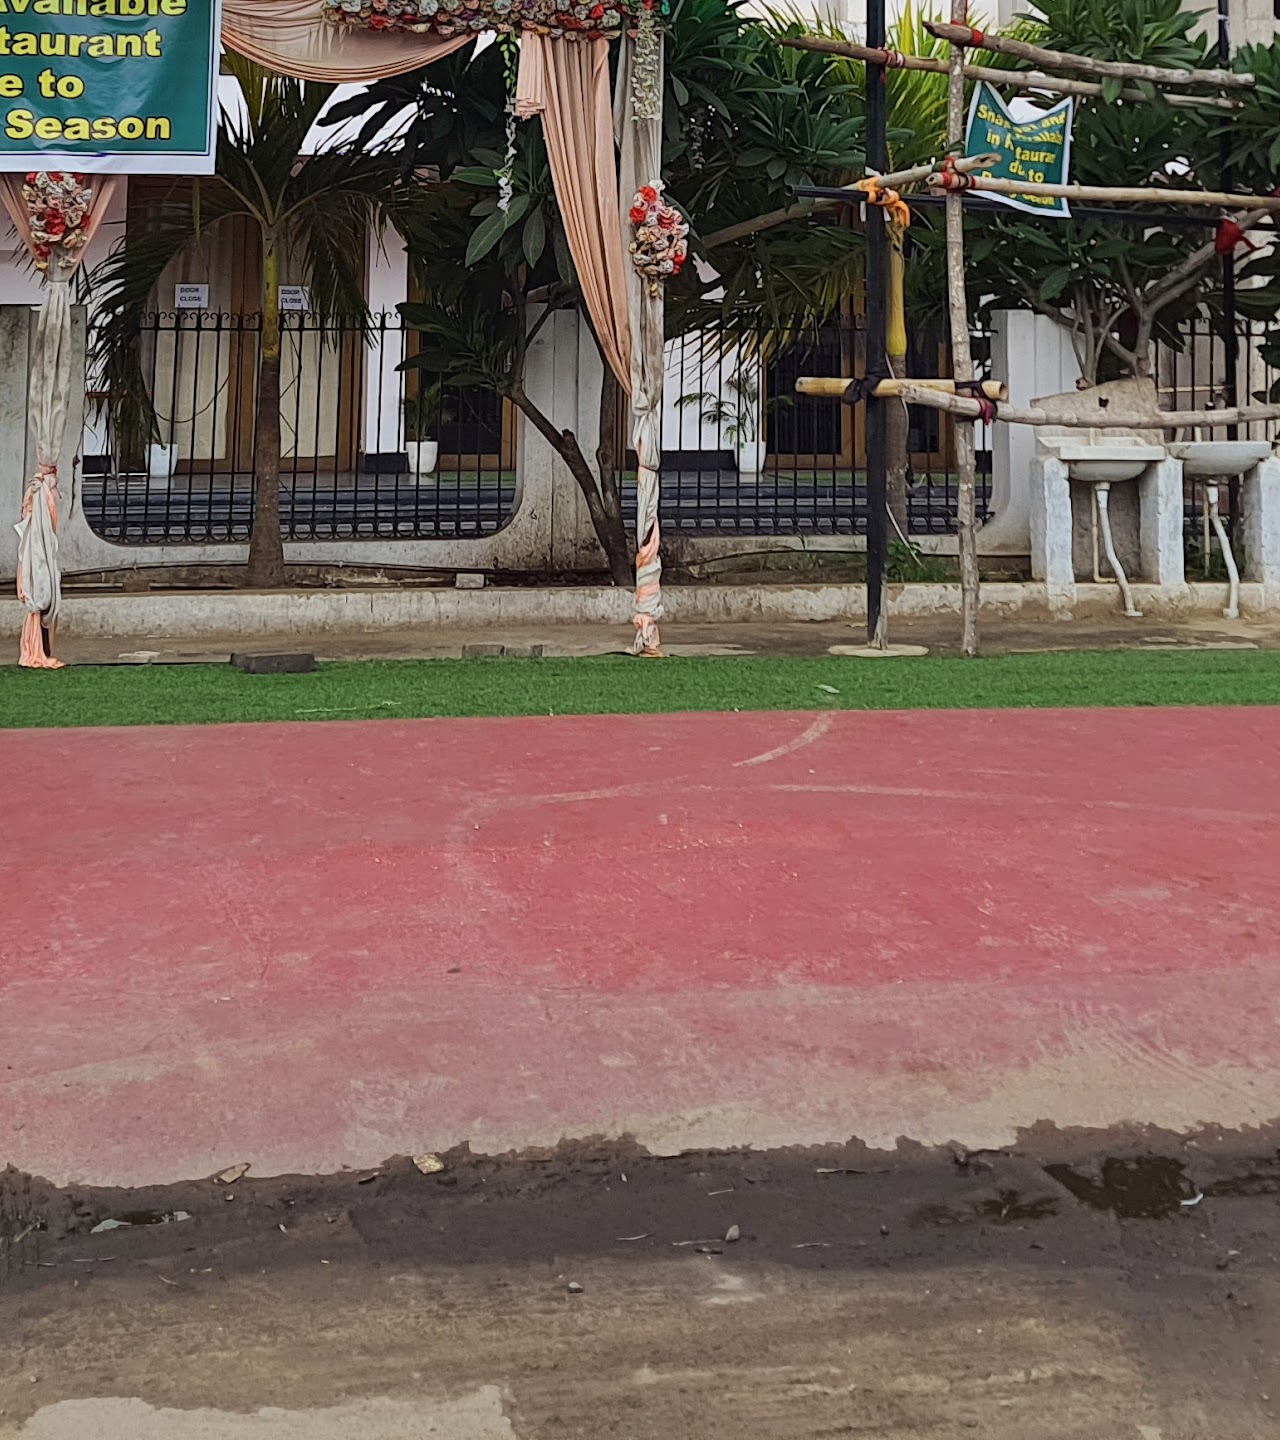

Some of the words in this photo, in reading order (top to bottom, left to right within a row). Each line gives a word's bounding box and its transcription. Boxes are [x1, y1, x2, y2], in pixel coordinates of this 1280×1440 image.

[38, 68, 85, 99] to
[5, 108, 172, 141] Season
[1028, 169, 1045, 183] to
